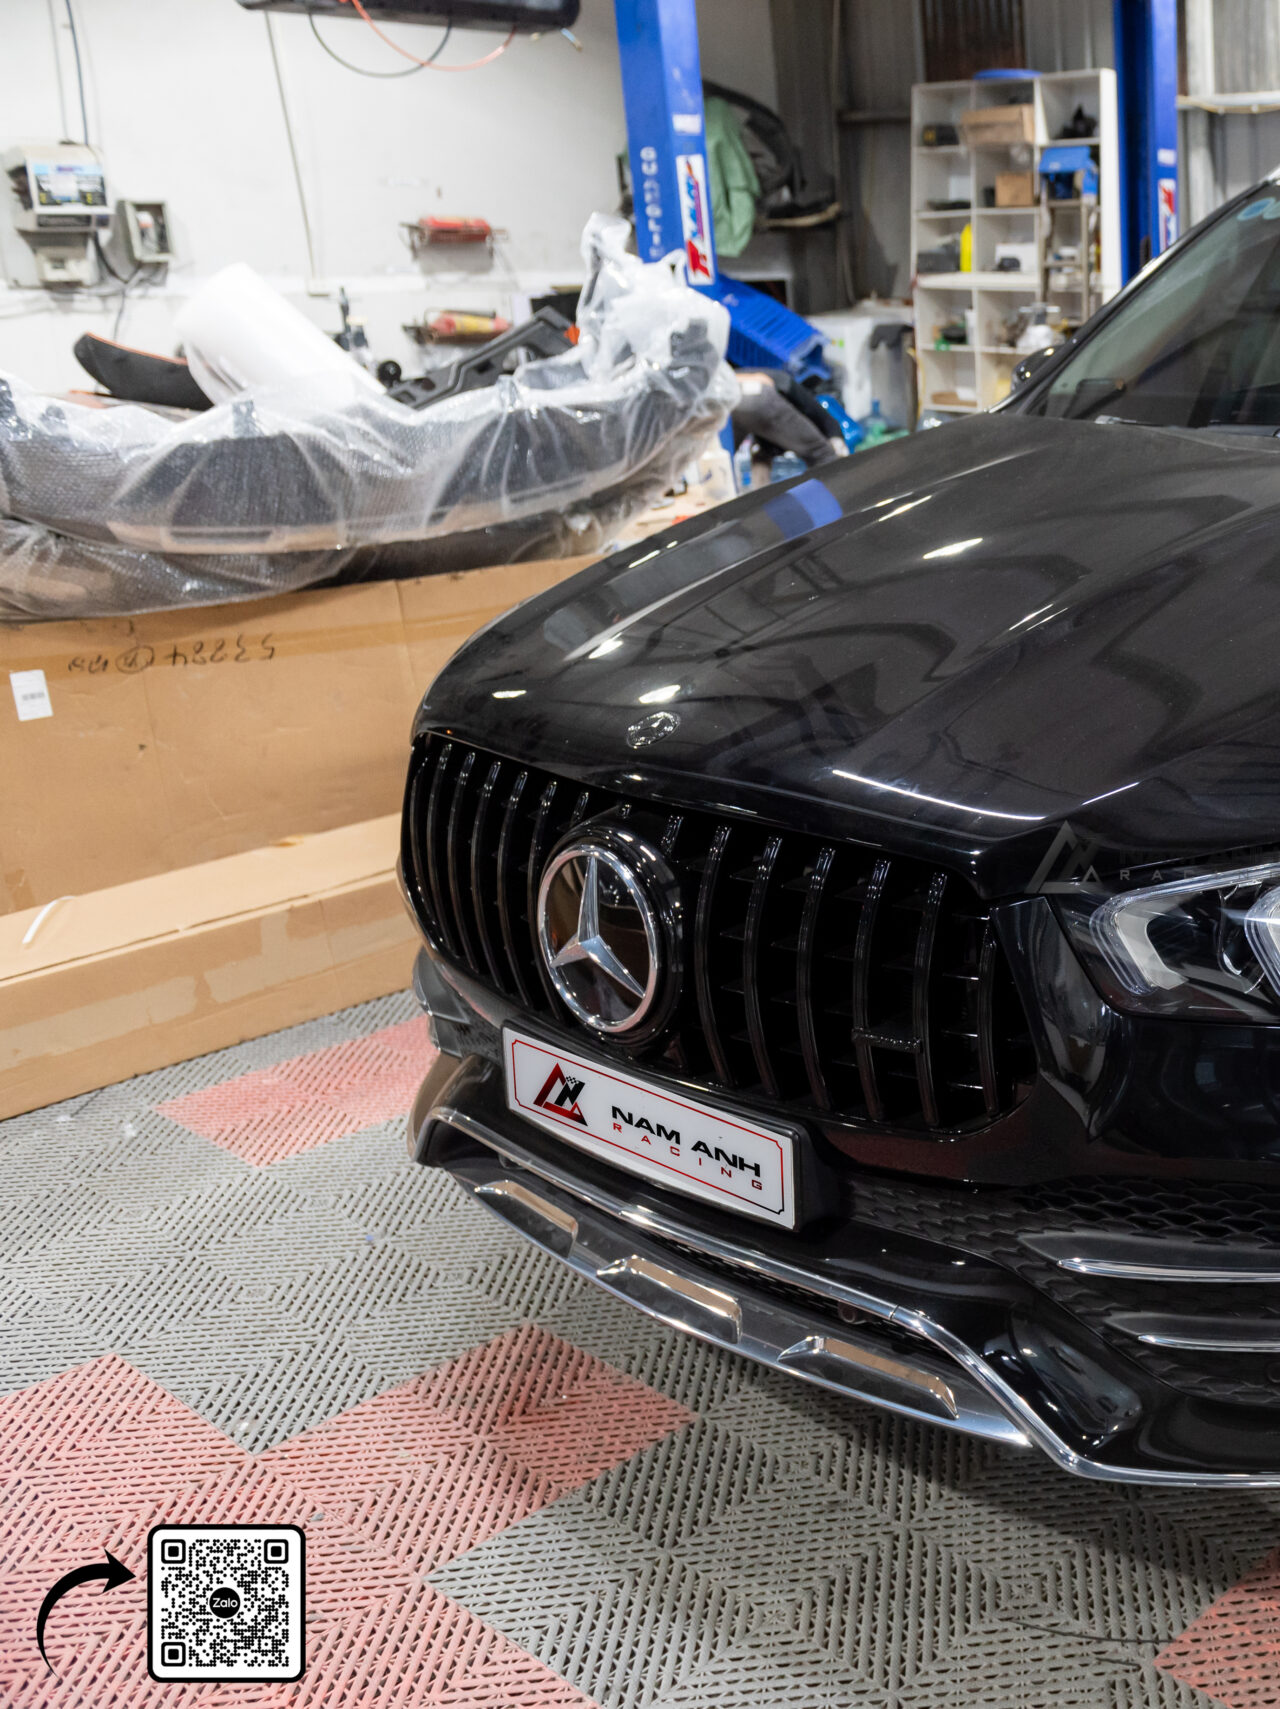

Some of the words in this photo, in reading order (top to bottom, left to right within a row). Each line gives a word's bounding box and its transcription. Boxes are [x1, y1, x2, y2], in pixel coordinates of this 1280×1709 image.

[611, 1105, 681, 1145] NAM
[691, 1140, 761, 1178] ANH
[612, 1122, 763, 1191] RACING
